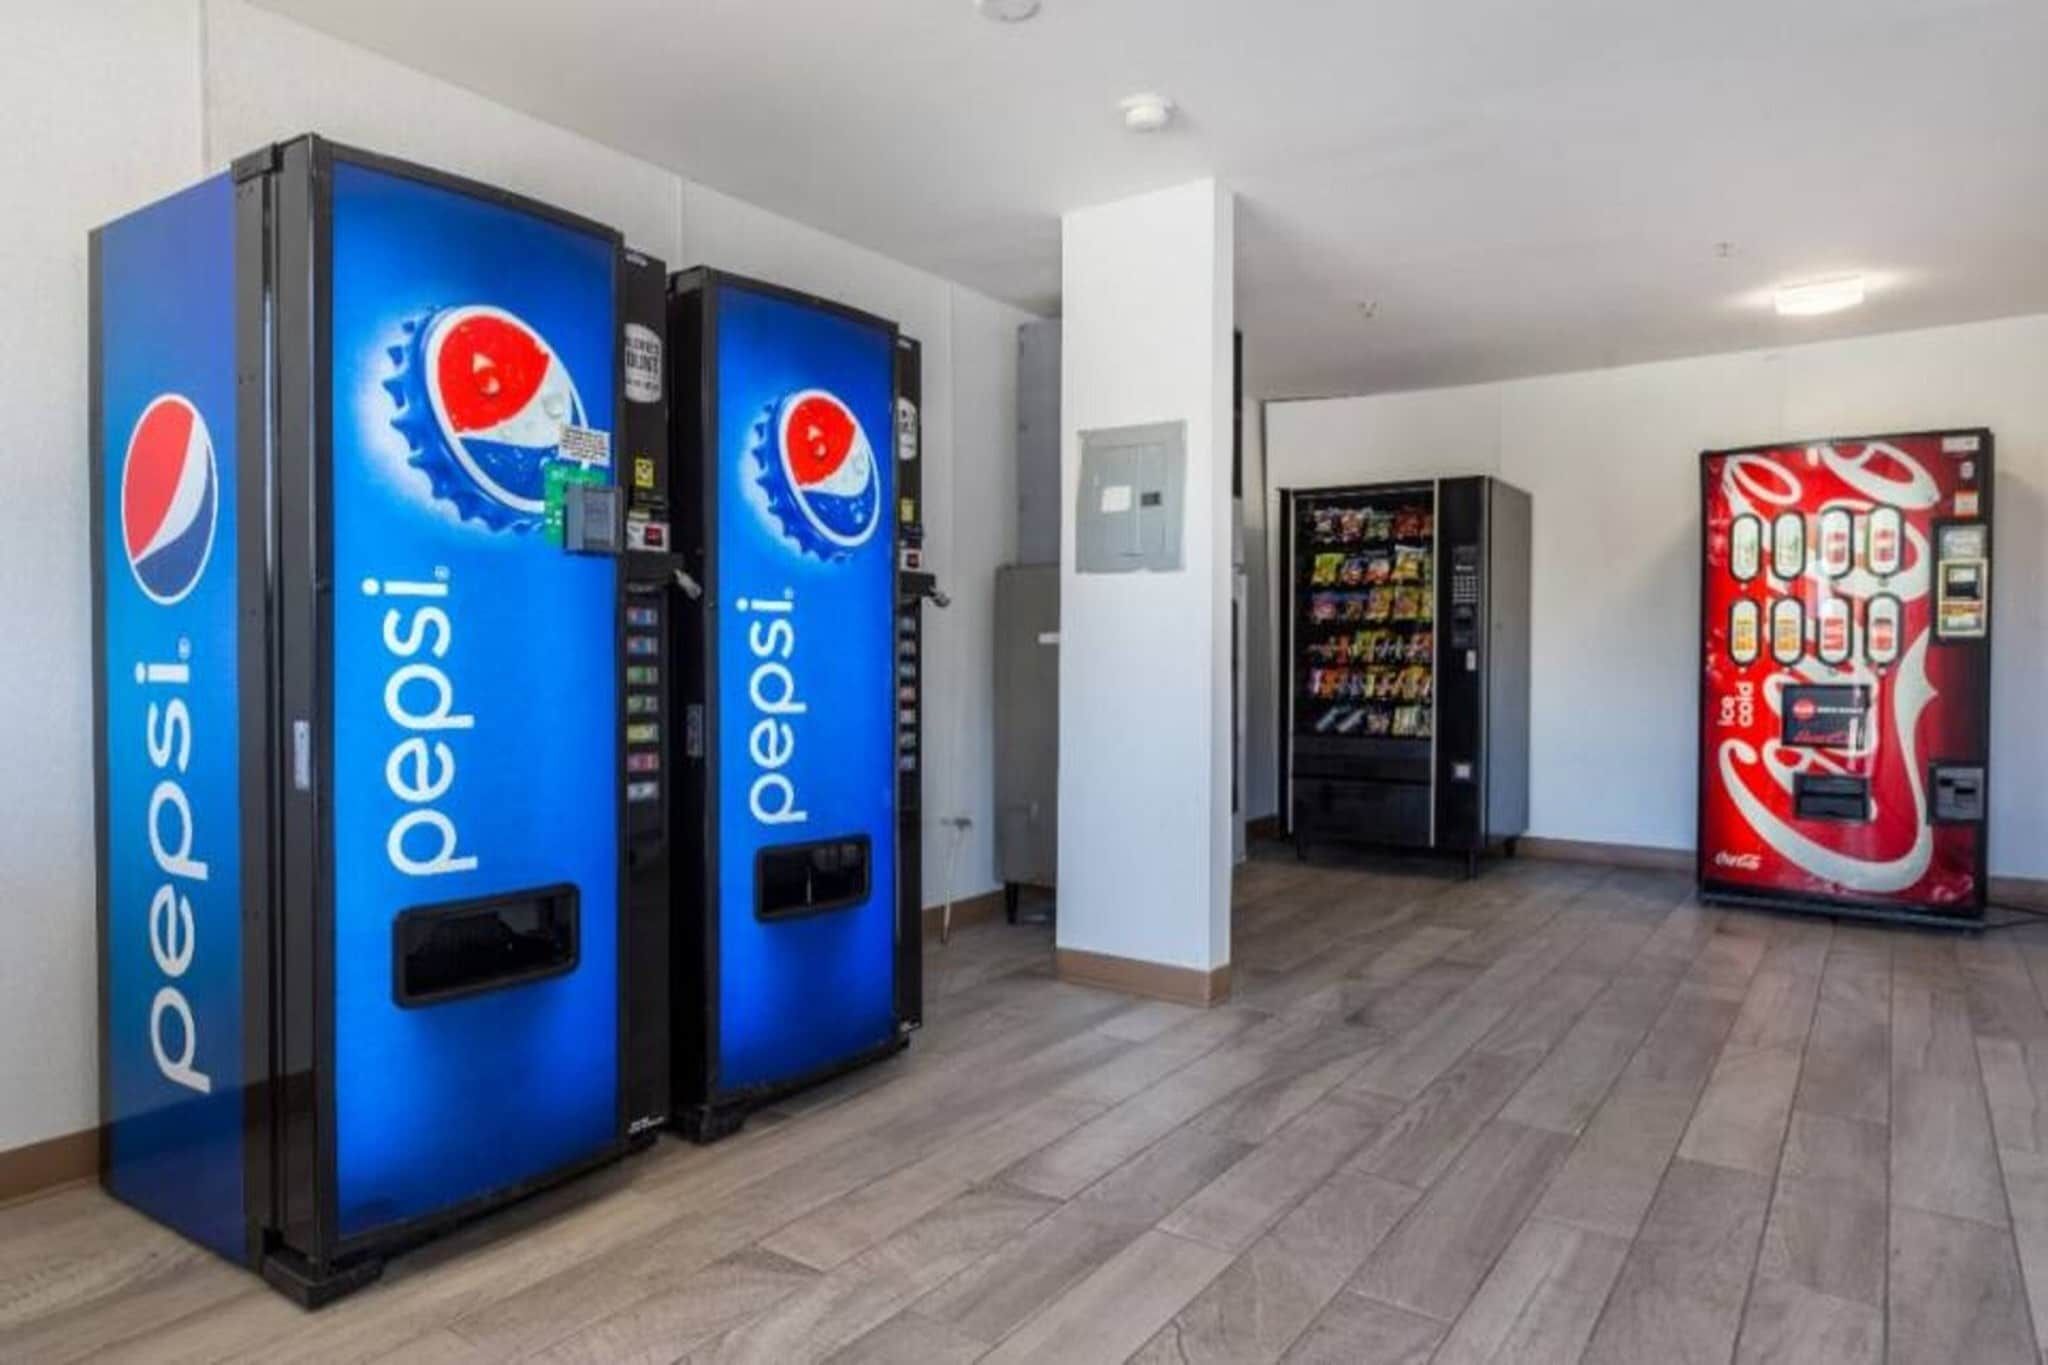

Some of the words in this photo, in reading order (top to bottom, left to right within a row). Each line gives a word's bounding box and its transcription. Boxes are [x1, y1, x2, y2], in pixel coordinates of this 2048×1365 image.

[363, 578, 477, 875] pepsi
[738, 598, 806, 823] pepsi
[1734, 682, 1755, 728] cold
[136, 662, 210, 1093] pepsi
